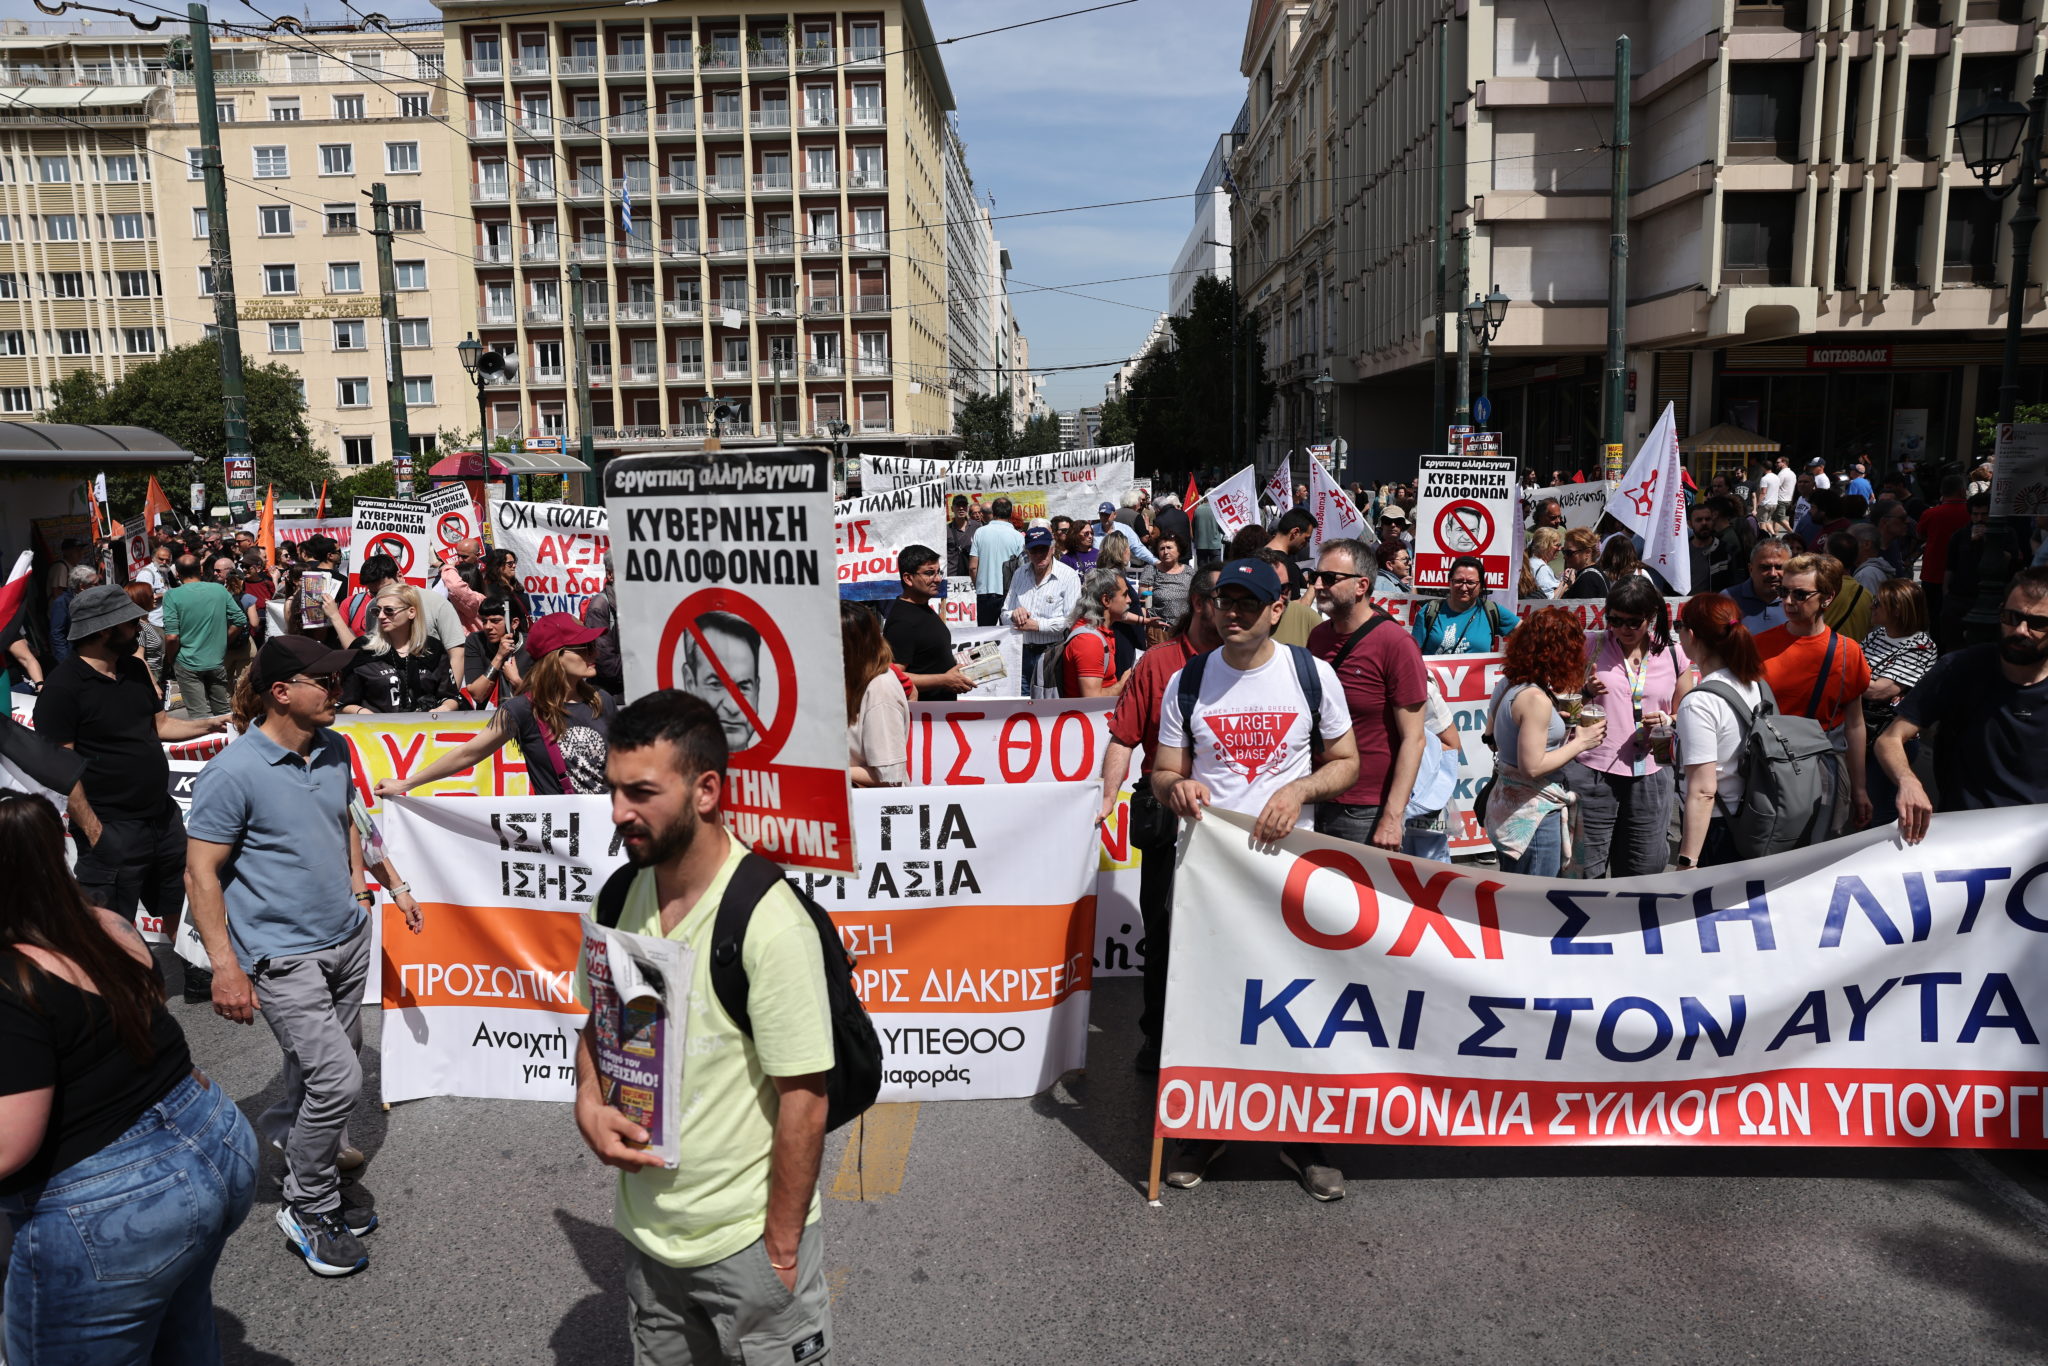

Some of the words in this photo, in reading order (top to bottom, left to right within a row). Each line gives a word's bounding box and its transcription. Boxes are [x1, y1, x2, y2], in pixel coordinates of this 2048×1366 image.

[312, 311, 330, 319] ΚΑΙ
[1813, 349, 1888, 363] ΚΩΤΣΟΒΟΛΟΣ
[872, 457, 910, 475] ΚΑΤΩ
[919, 459, 936, 475] ΤΑ
[995, 458, 1022, 473] ΑΠΟ
[1052, 445, 1135, 469] ΜΟΝΙΜΟΤΗΤΑ
[615, 463, 695, 494] εργατικη
[699, 462, 815, 494] αλληλεγγυη
[990, 469, 1058, 489] ΑΥΞΗΣΕΙΣ
[1427, 472, 1507, 486] ΚΥΒΕΡΝΗΣΗ
[431, 491, 466, 508] ΒΕΡΝΗΣΗ
[1423, 486, 1510, 500] ΔΟΛΟΦΟΝΩΝ
[356, 520, 426, 534] ΔΟΛΟΦΟΝΩΝ
[359, 510, 424, 524] ΚΥΒΕΡΝΗΣΗ
[499, 502, 538, 530] ΟΧΙ
[626, 505, 808, 542] ΚΥΒΕΡΝΗΣΗ
[625, 549, 820, 586] ΔΟΛΟΦΟΝΩΝ
[1224, 732, 1276, 748] SOUDA
[1235, 749, 1266, 761] BASE
[726, 768, 782, 810] ΤΗΝ
[491, 812, 579, 857] ΙΣΗ
[881, 803, 977, 851] ΓΙΑ
[501, 861, 595, 902] ΙΣΗΣ
[1280, 848, 1507, 960] ΟΧΙ
[1549, 879, 1776, 955] ΣΤΗ
[851, 968, 909, 1002] ΩΡΙΣ
[920, 952, 1083, 1003] ΔΙΑΚΡΙΣΕΙΣ
[1239, 978, 1425, 1049] ΚΑΙ
[1457, 994, 1746, 1062] ΣΤΟΝ
[1765, 972, 2040, 1052] ΑΥΤΑ
[472, 1021, 568, 1059] Ανοιχτή
[883, 1026, 1026, 1056] ΥΠΕΘΟΟ
[522, 1064, 551, 1084] για
[880, 1064, 972, 1089] ιαφοράς
[600, 1058, 660, 1088] ΑΡΞΙΣΜΟ!
[625, 1057, 641, 1069] τον
[1158, 1079, 1534, 1137] ΟΜΟΝΣΠΟΝΔΙΑ
[1548, 1082, 1811, 1136] ΣΥΛΛΟΓΩΝ
[1824, 1082, 2048, 1139] ΥΠΟΥΡΓ
